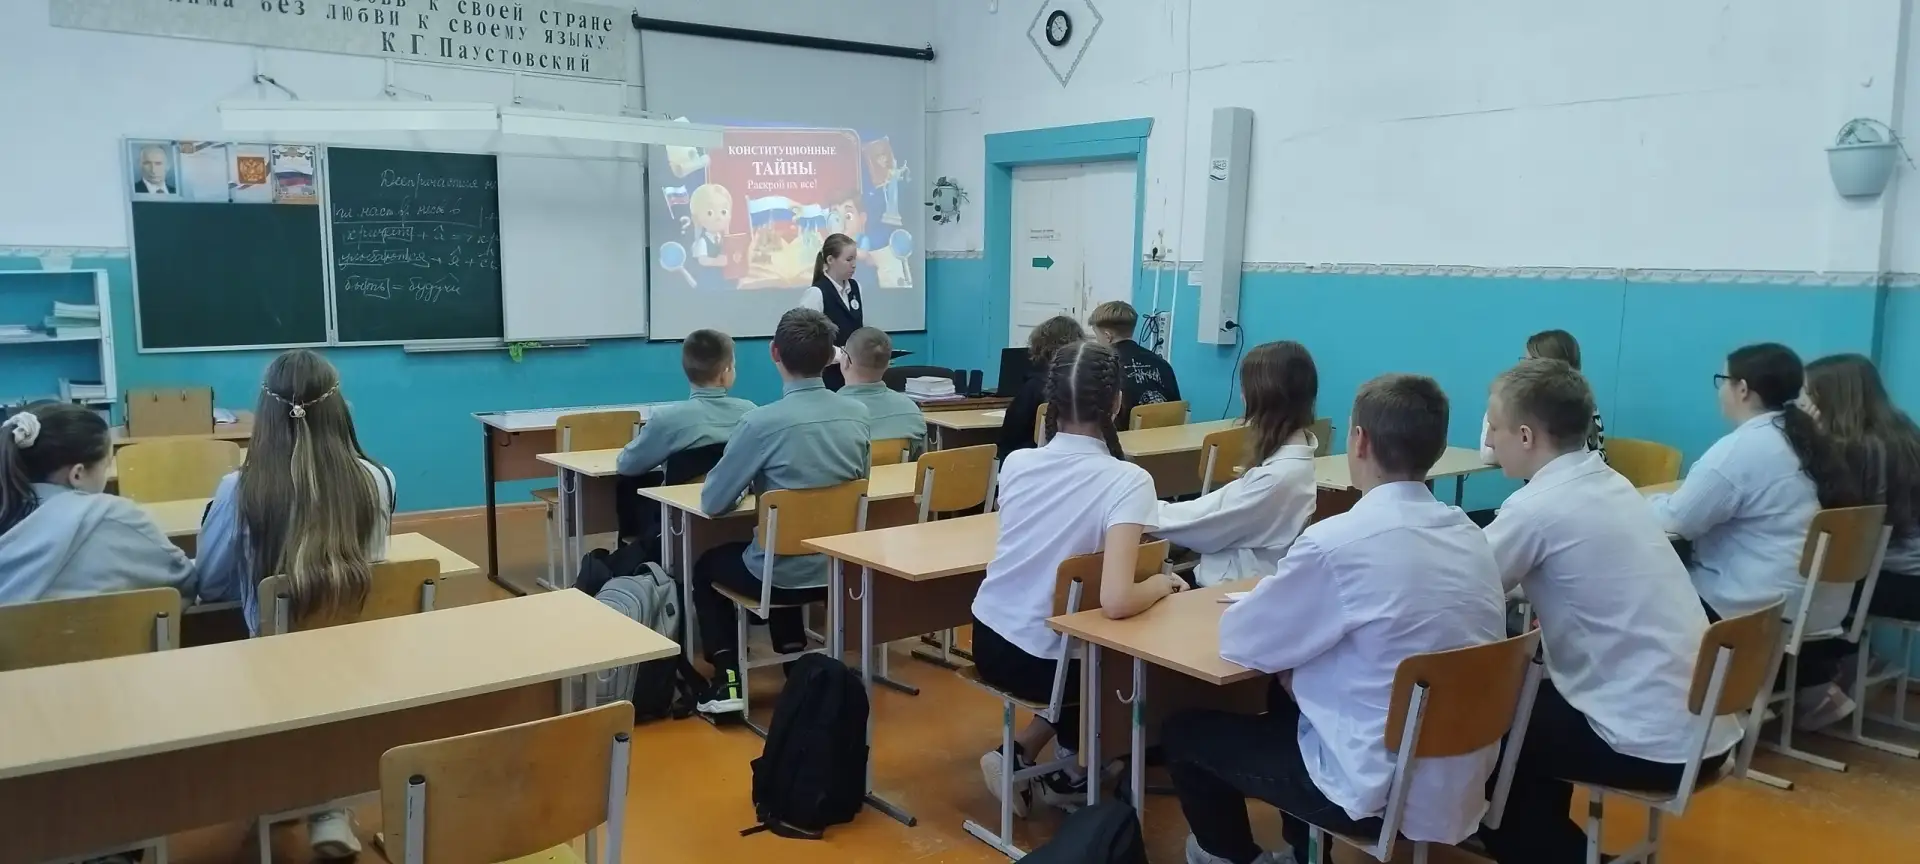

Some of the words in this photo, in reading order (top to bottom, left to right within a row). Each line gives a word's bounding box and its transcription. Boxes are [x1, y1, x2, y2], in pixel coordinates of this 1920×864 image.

[326, 4, 399, 26] любви
[418, 13, 429, 29] к
[448, 17, 528, 41] своему
[457, 0, 523, 21] своей
[539, 9, 613, 32] стране
[439, 36, 590, 72] Паустовский
[728, 145, 838, 155] КОНСТИТУЦИОННЫЕ
[752, 157, 817, 176] ТАЙНЫ:
[747, 179, 784, 192] Раскрой
[787, 180, 798, 189] их
[800, 178, 818, 189] все!
